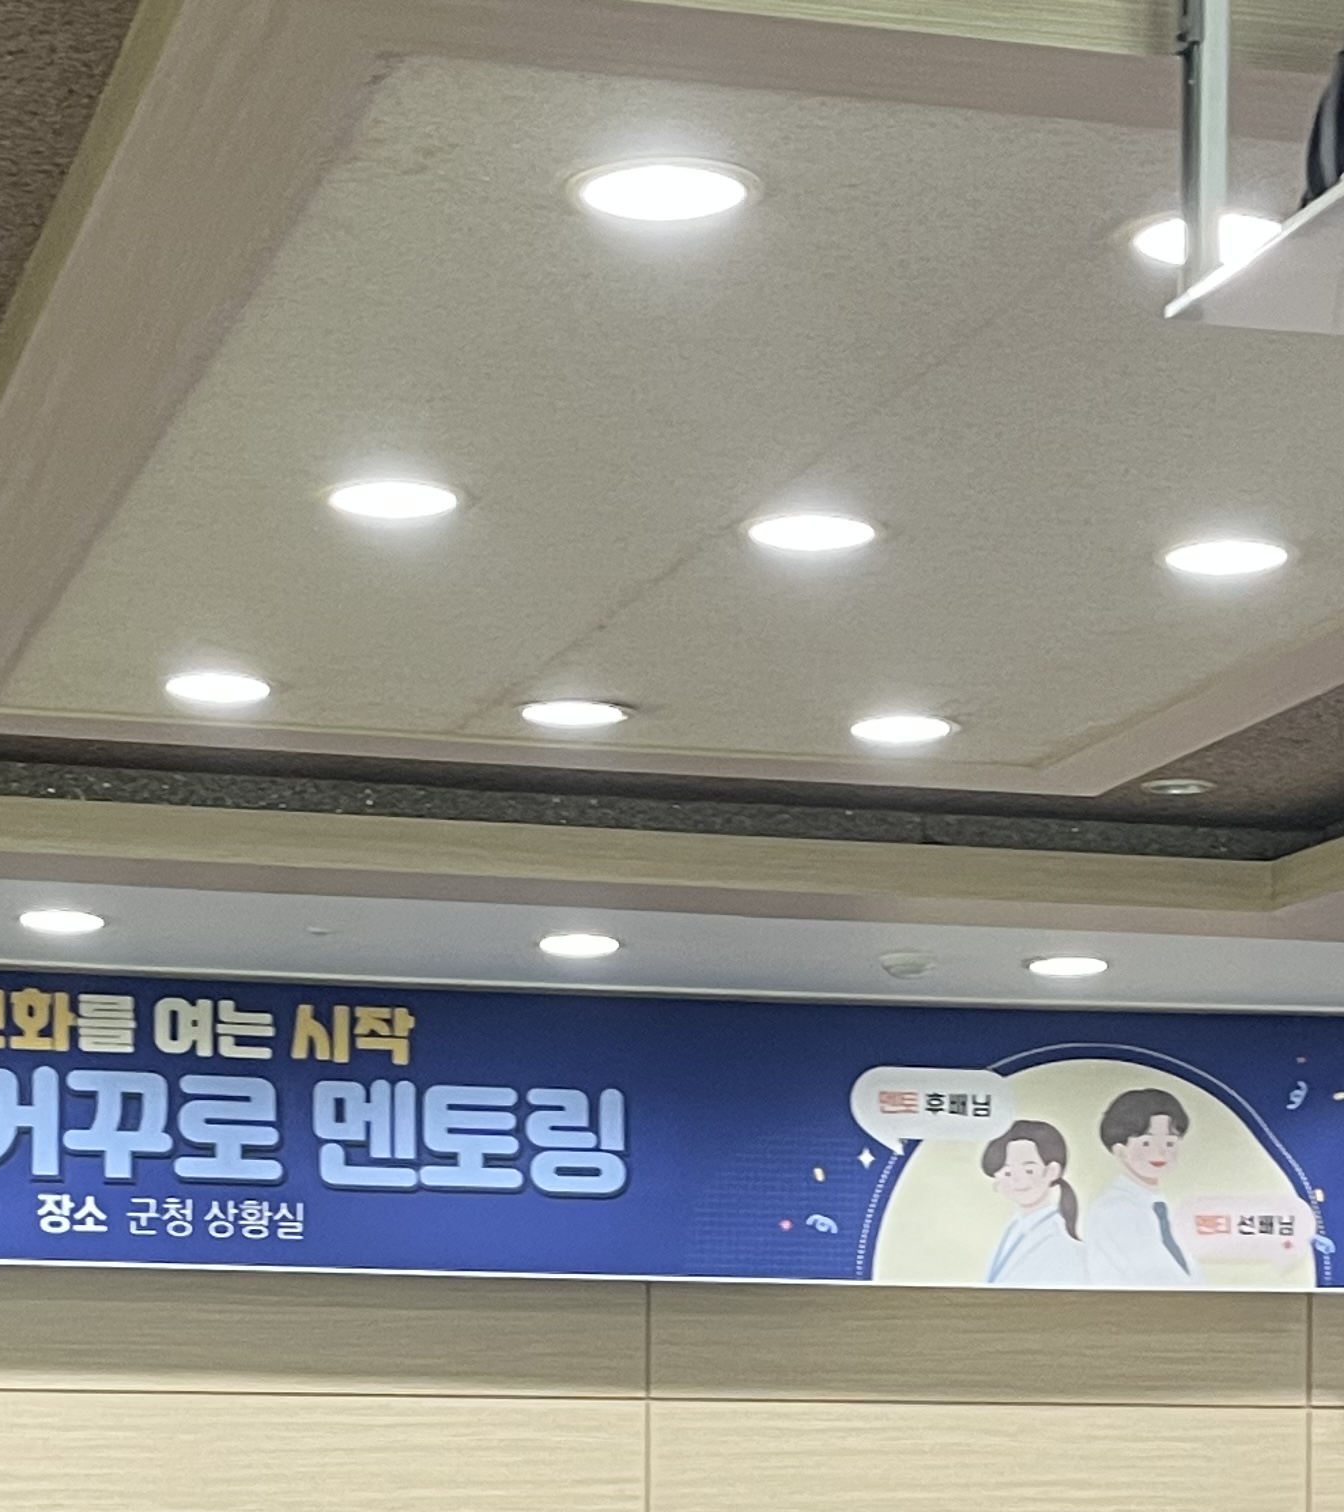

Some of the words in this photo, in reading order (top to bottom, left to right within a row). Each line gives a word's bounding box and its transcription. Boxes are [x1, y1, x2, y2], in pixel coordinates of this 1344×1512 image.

[154, 995, 276, 1061] 여는
[291, 1003, 415, 1065] 시작
[312, 1079, 629, 1197] 멘토링
[36, 1193, 109, 1234] 장소
[125, 1197, 194, 1237] 군청
[203, 1199, 305, 1240] 상황실
